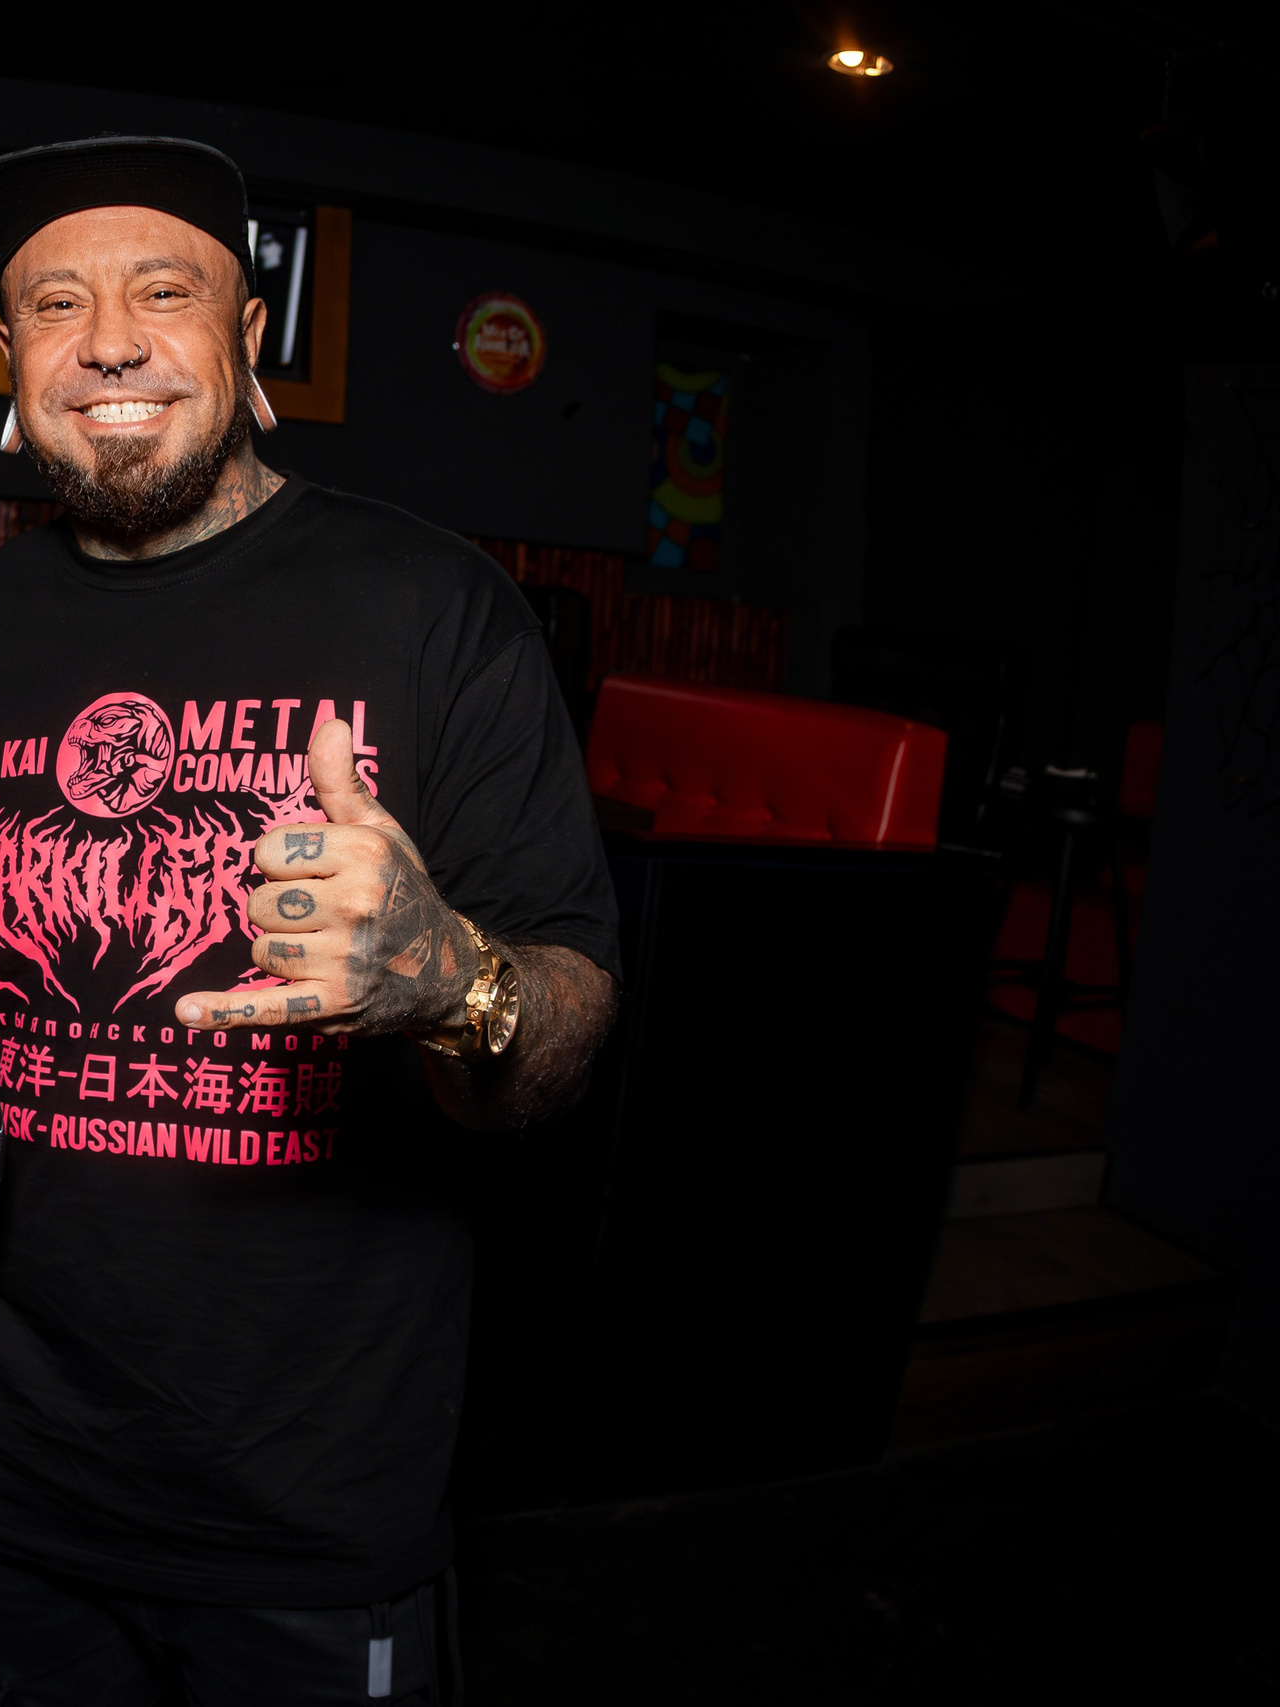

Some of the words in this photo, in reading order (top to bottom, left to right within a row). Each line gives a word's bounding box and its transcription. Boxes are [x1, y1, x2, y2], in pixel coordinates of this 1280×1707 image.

[0, 736, 49, 780] KAI
[172, 752, 380, 799] COMANS
[250, 1032, 350, 1052] МОРЯ
[51, 1112, 178, 1159] RUSSIAN
[182, 1125, 261, 1167] WILD
[266, 1127, 340, 1167] EAST
